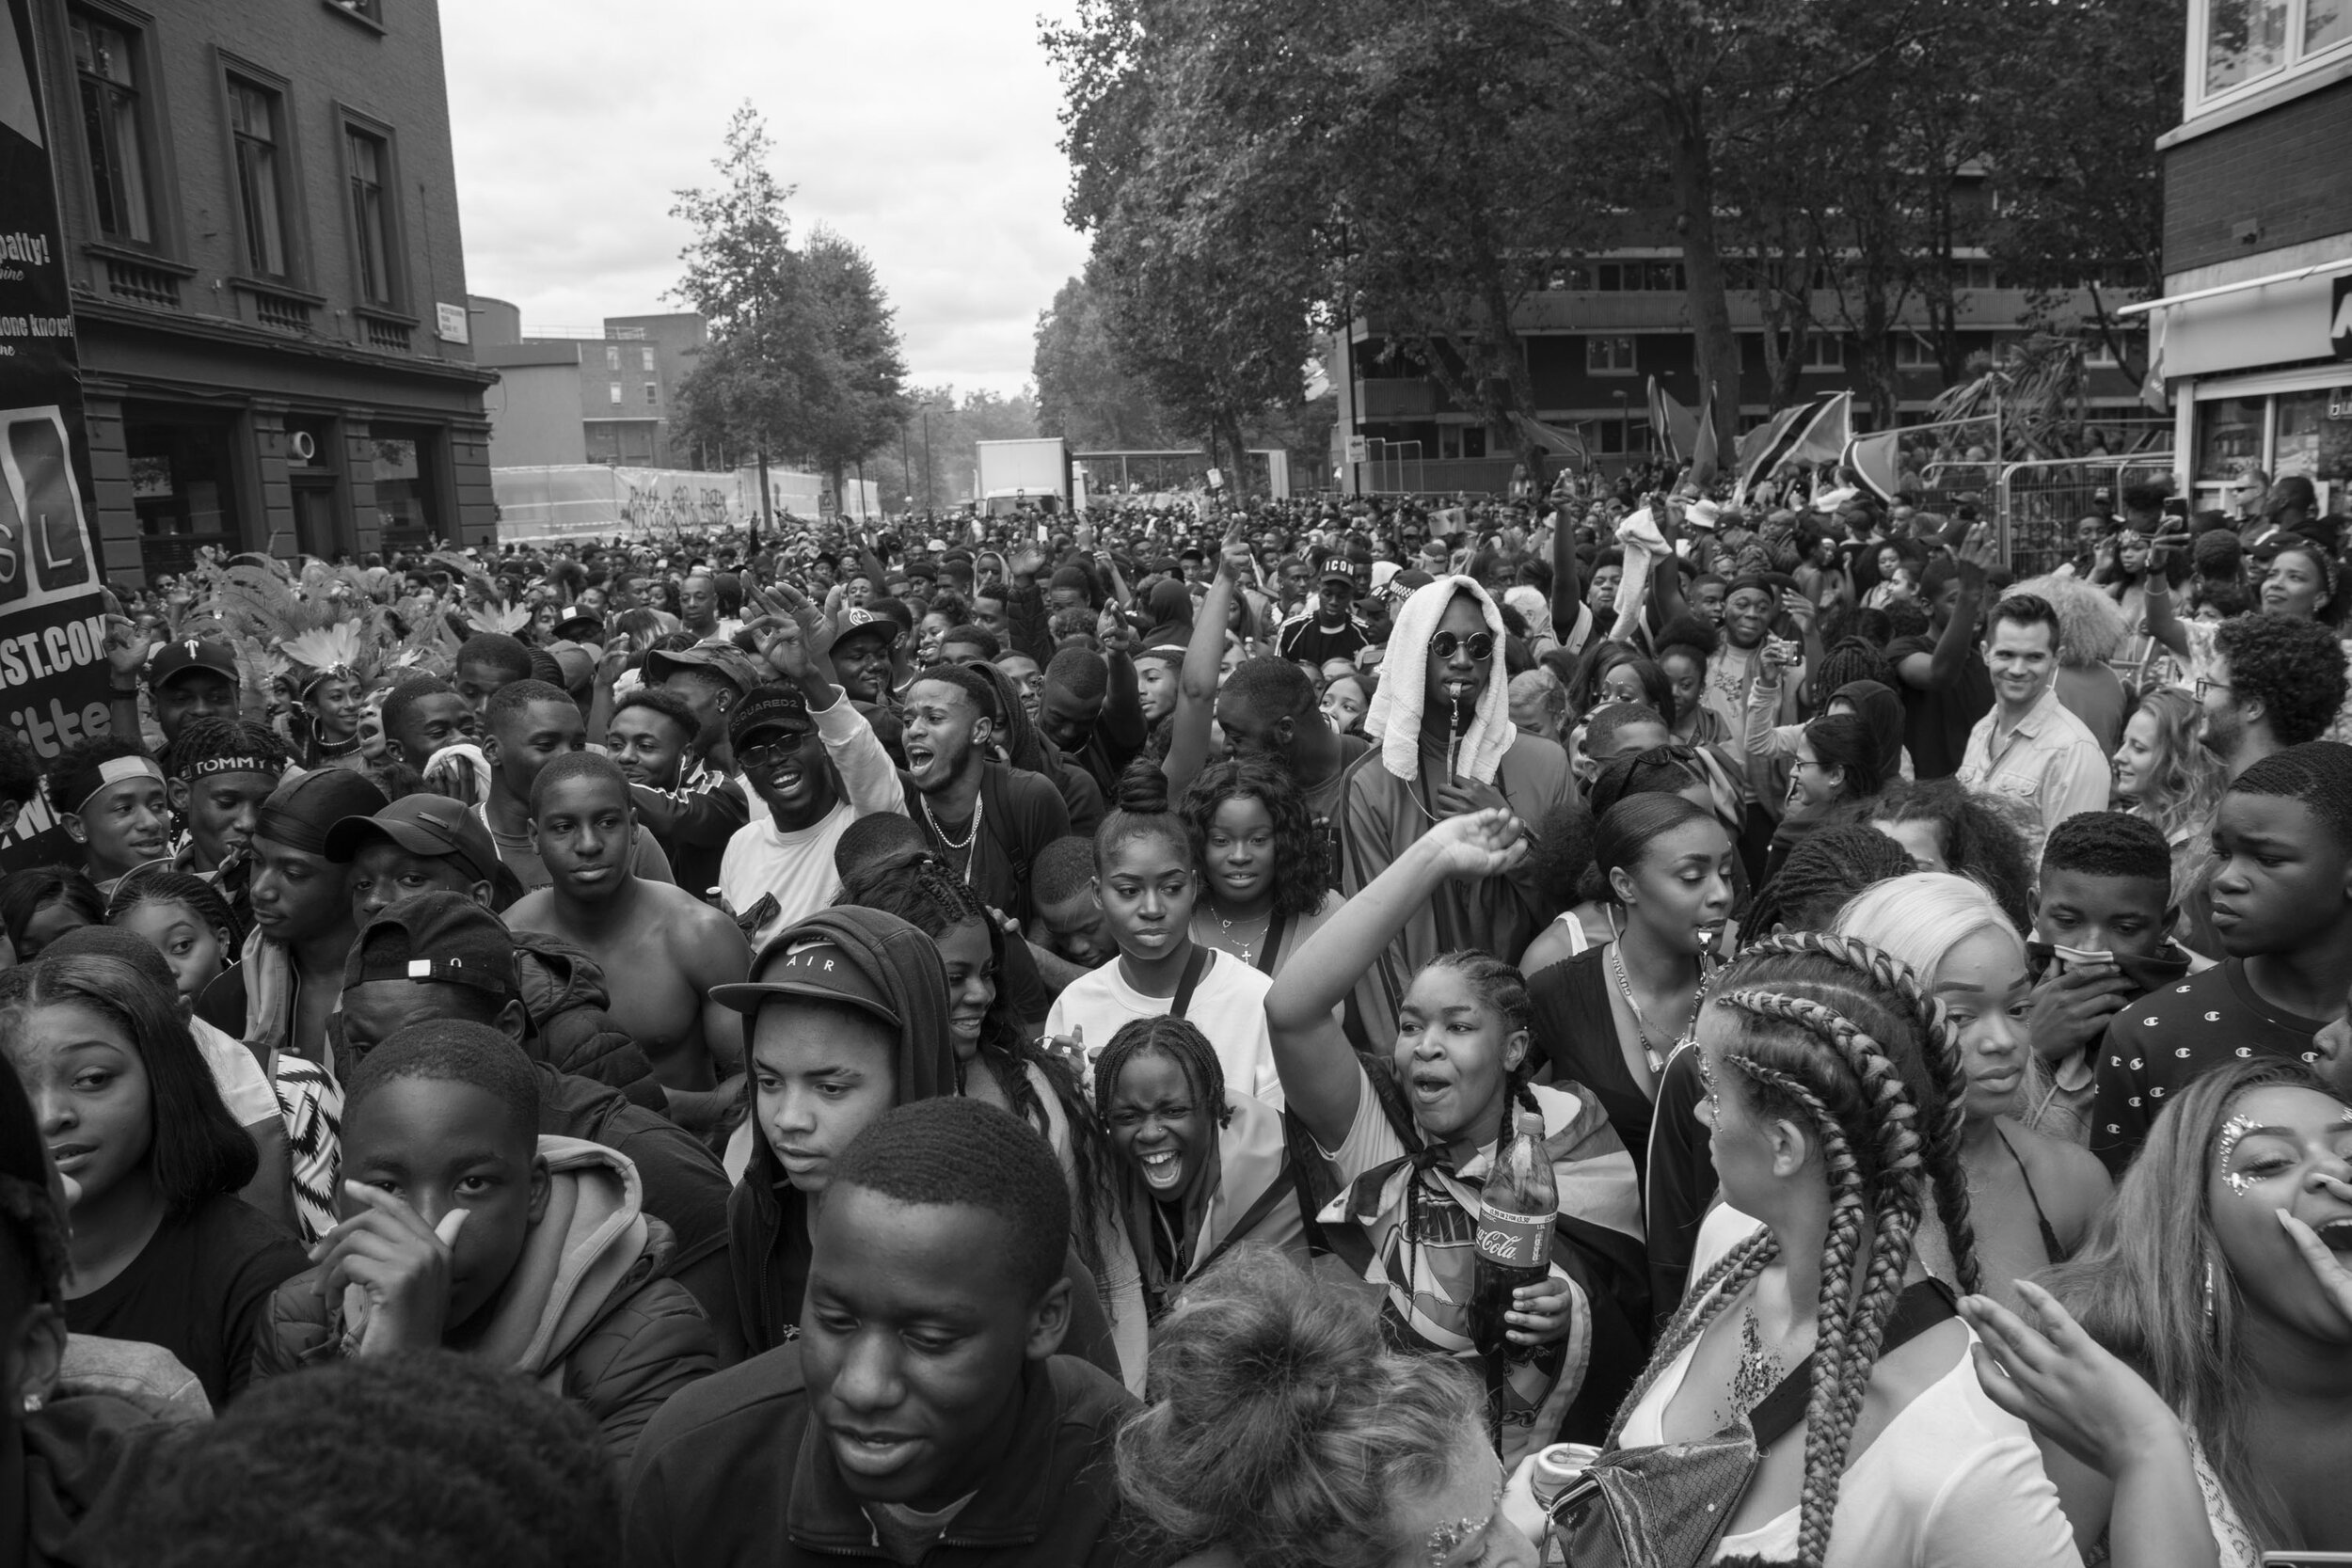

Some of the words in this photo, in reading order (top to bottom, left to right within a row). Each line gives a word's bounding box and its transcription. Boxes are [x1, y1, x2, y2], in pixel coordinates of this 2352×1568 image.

[29, 313, 74, 337] know!
[1325, 560, 1354, 576] ICON
[196, 756, 265, 775] TOMMY
[786, 955, 834, 972] AIR
[1612, 954, 1632, 996] GUYANA
